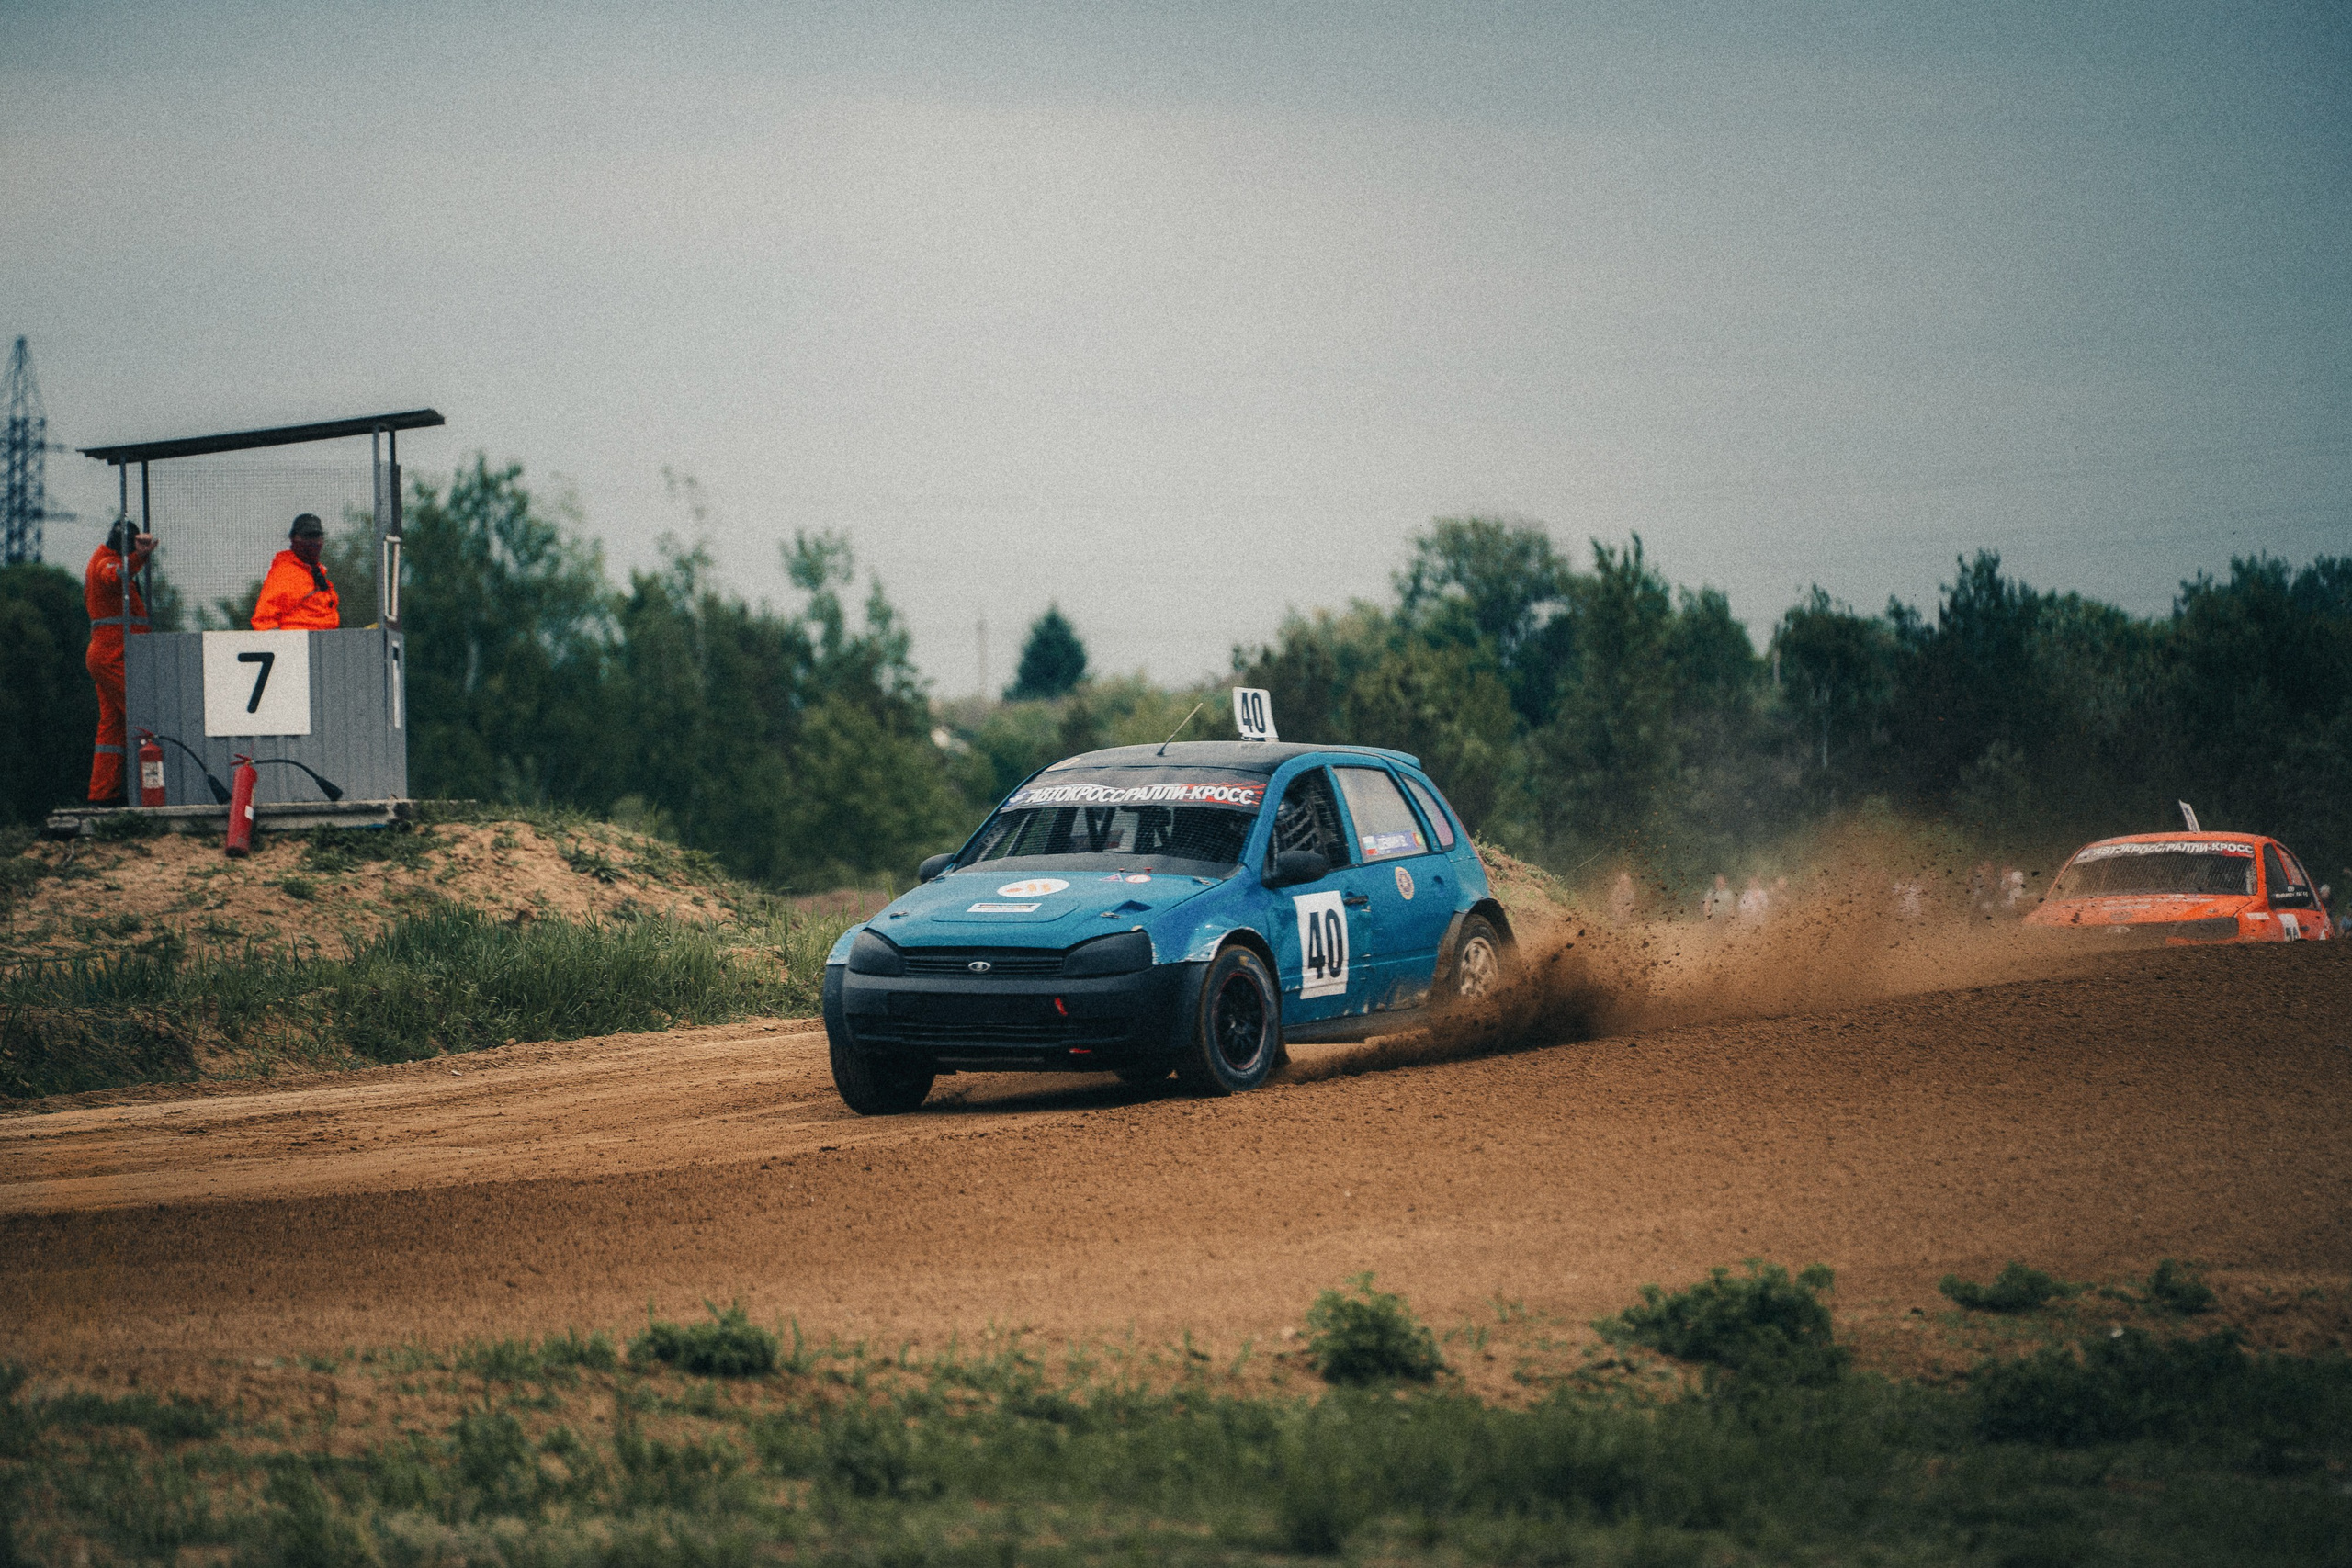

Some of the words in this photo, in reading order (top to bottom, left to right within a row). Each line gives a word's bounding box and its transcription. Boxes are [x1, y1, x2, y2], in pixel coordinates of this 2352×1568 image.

[237, 652, 275, 714] 7
[1241, 692, 1266, 733] 40
[1308, 908, 1343, 979] 40
